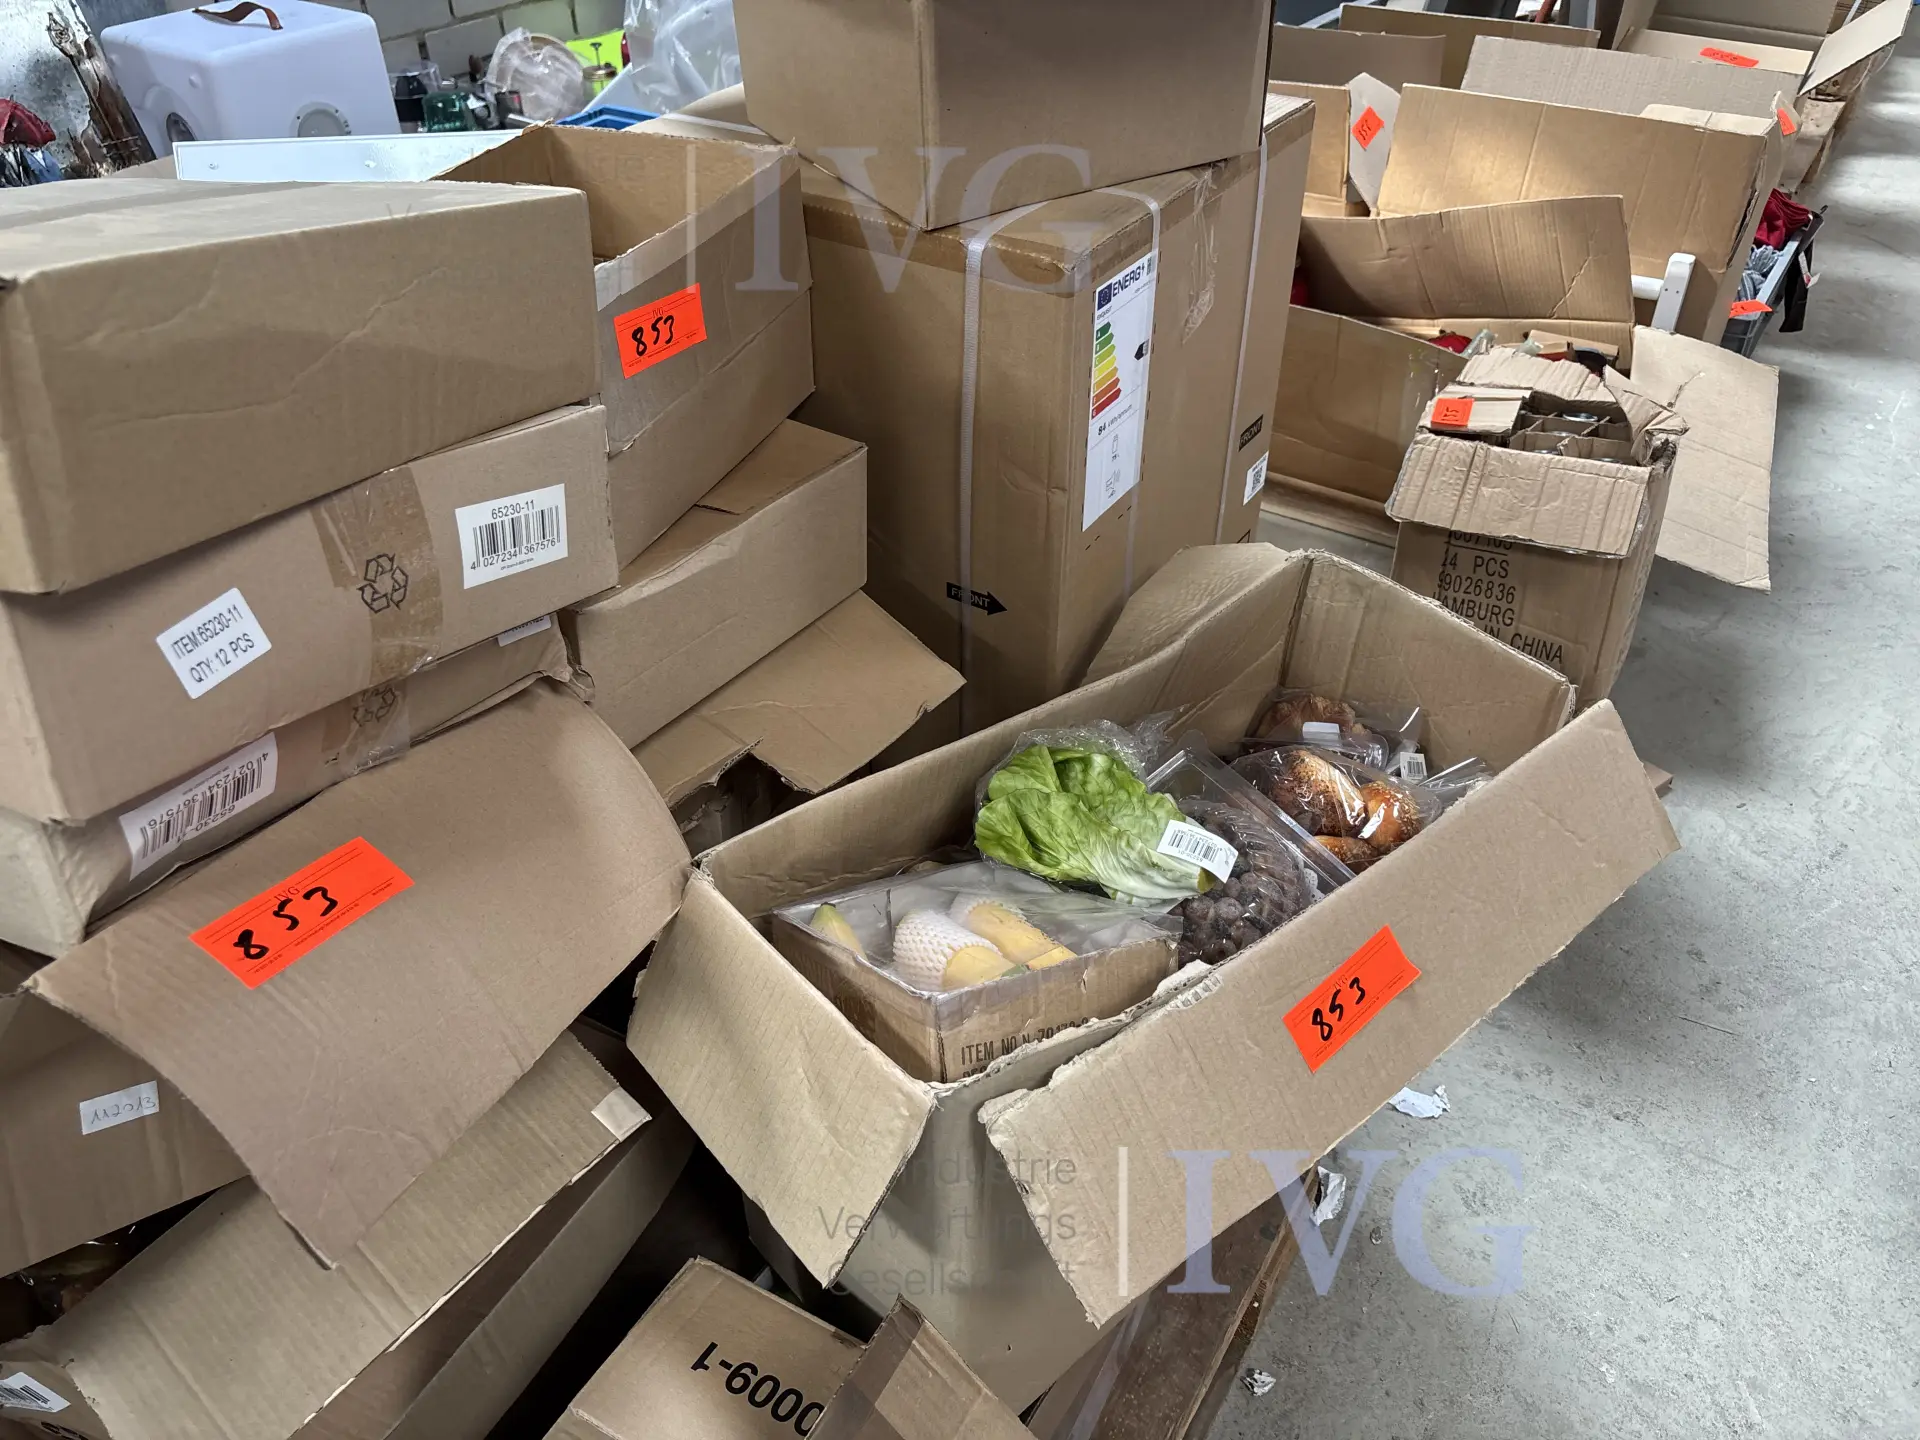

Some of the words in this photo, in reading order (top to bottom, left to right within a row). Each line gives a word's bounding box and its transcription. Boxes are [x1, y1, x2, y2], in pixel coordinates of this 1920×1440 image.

[632, 315, 674, 356] 853
[491, 499, 536, 520] 65230-11
[470, 560, 477, 571] 4
[483, 549, 518, 568] 027234
[524, 537, 556, 555] 367576
[1473, 555, 1510, 579] PCS
[189, 657, 219, 683] QTY:
[215, 648, 232, 667] 12
[229, 633, 255, 659] PCS
[1510, 633, 1563, 664] CHINA
[233, 886, 338, 960] 853
[1312, 977, 1366, 1041] 853
[961, 1040, 994, 1065] ITEM
